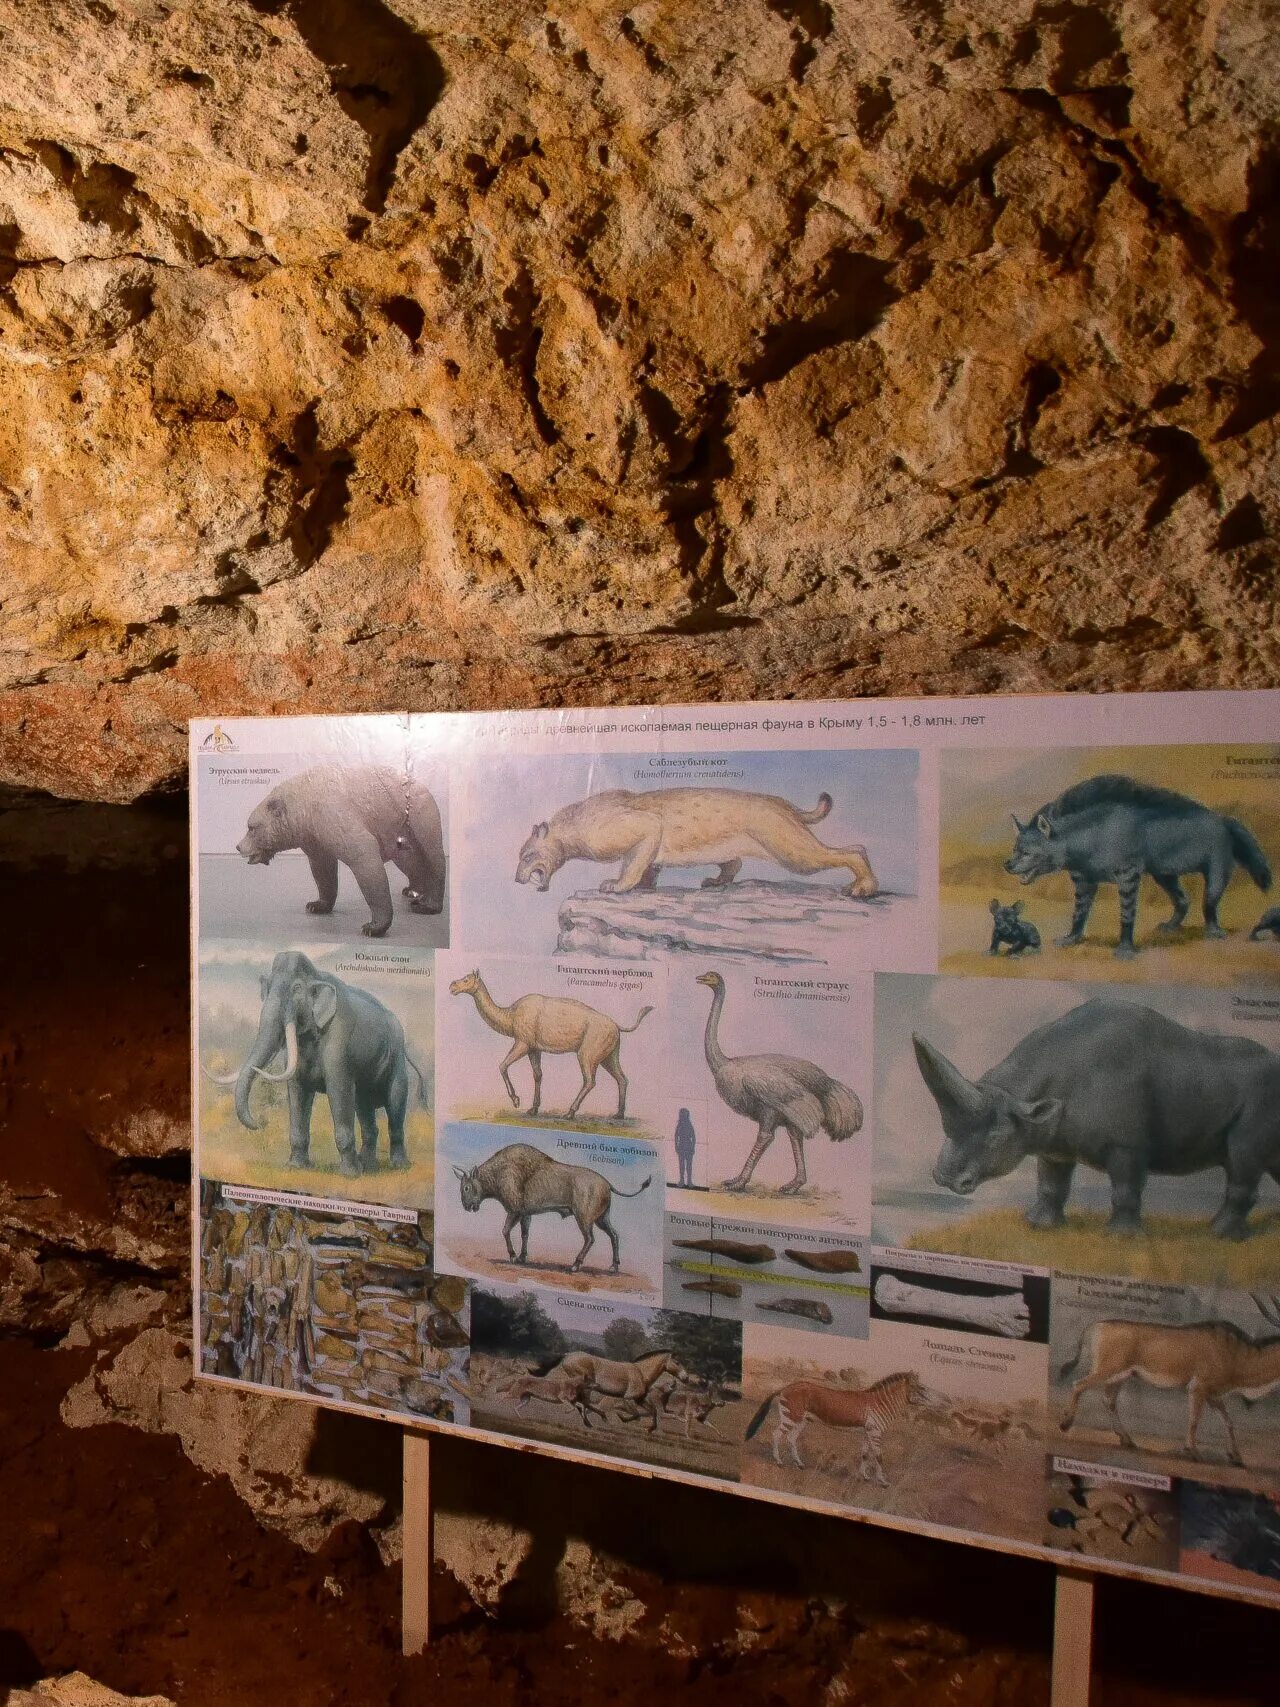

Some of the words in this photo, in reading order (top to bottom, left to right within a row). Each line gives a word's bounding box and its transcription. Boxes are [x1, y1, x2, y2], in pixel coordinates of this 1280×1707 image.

[545, 723, 617, 737] древнейшая
[620, 721, 692, 733] ископаемая
[695, 720, 758, 734] пещерная
[762, 718, 803, 731] фауна
[808, 721, 815, 729] в
[819, 717, 863, 730] Крыму
[868, 716, 887, 728] 1,5
[902, 716, 921, 727] 1,8
[926, 717, 957, 727] млн.
[962, 715, 986, 726] лет
[649, 758, 708, 768] Саблезубый
[208, 767, 247, 777] Этрусский
[355, 953, 389, 962] Южный
[558, 965, 610, 976] Гигантский
[612, 967, 653, 978] верблюд
[567, 977, 617, 989] (Paracamelus
[619, 980, 643, 991] gigas)
[754, 975, 813, 988] Гигантский
[817, 981, 850, 992] страус
[556, 1139, 596, 1150] Древний
[600, 1143, 618, 1153] бык
[224, 1187, 302, 1206] Палеонтологические
[303, 1199, 335, 1211] находки
[348, 1205, 380, 1217] пещеры
[382, 1209, 417, 1221] Таврида
[670, 1215, 710, 1228] Роговые
[758, 1228, 816, 1243] винторогих
[819, 1236, 863, 1249] антилоп
[557, 1297, 584, 1309] Сцена
[587, 1303, 615, 1314] охоты
[922, 1339, 966, 1353] Лошадь
[1058, 1459, 1108, 1477] Находки
[1122, 1472, 1168, 1487] пещере
